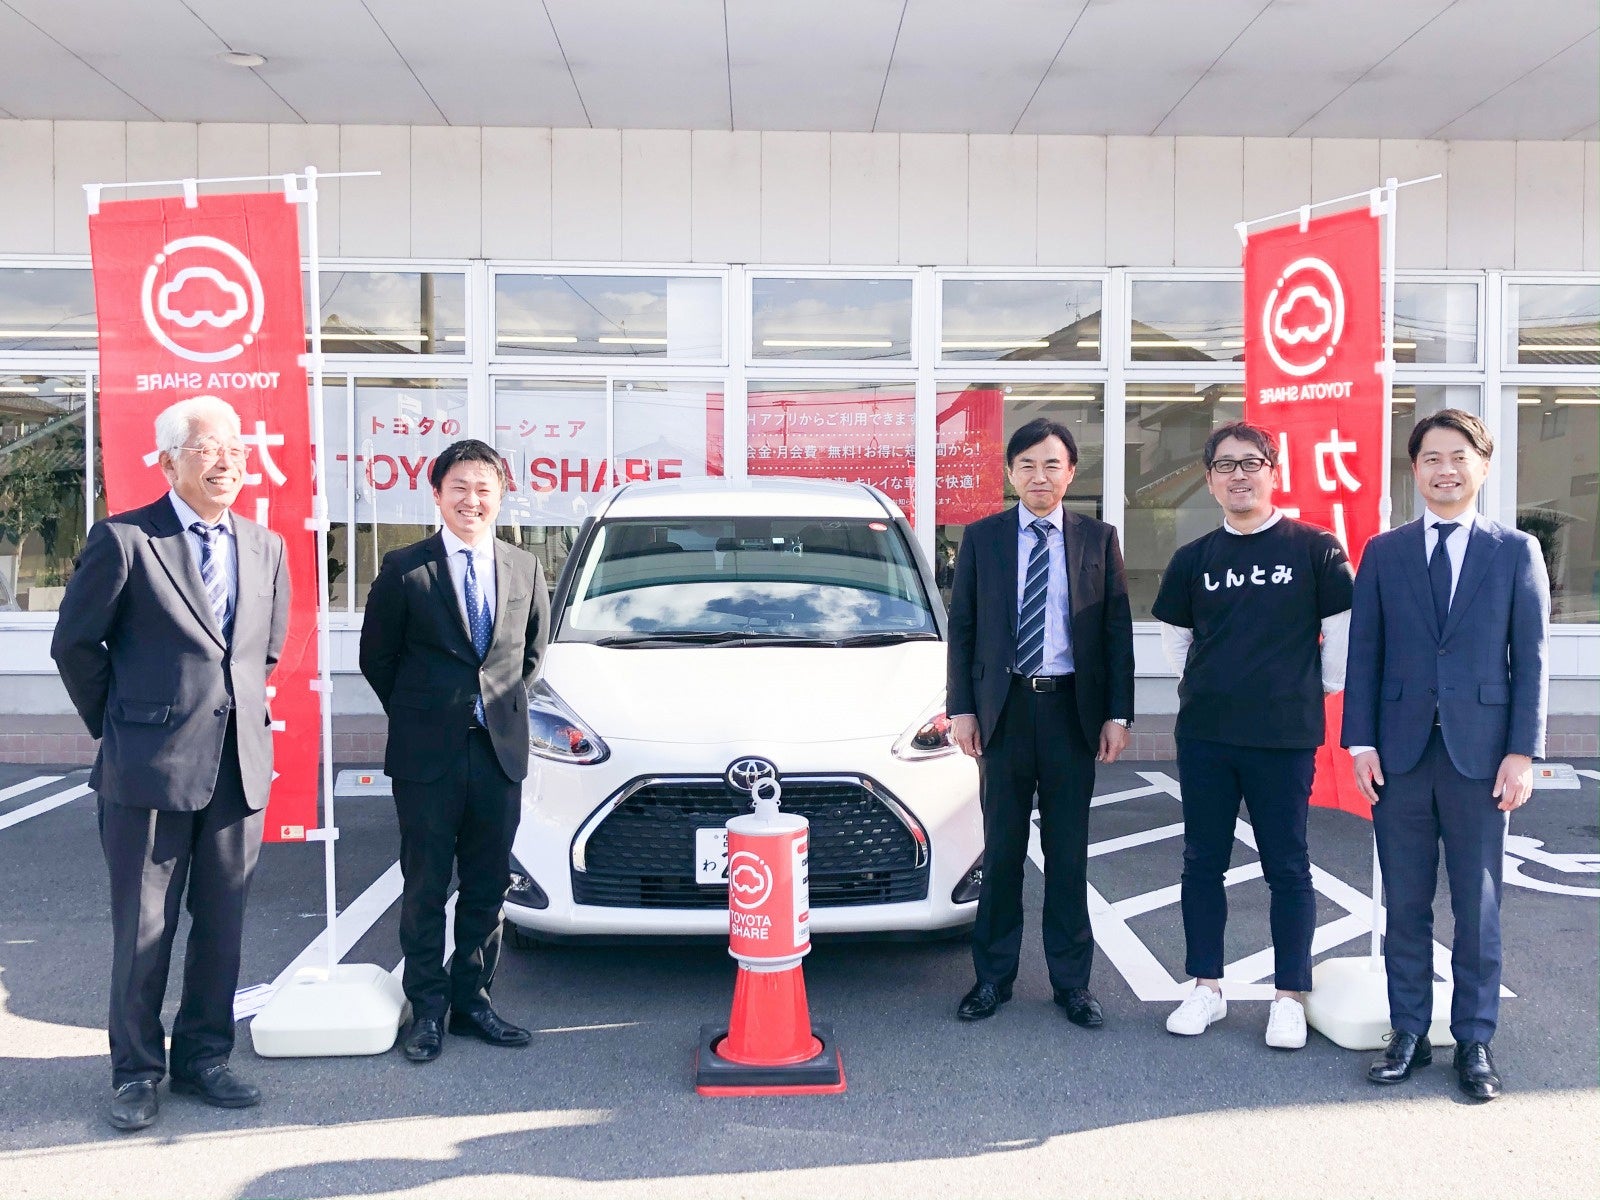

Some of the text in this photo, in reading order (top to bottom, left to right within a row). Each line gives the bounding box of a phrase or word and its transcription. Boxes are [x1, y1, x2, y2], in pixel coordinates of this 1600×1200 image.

[372, 415, 586, 438] トヨタのーシェア
[1203, 564, 1293, 591] しんとみ
[730, 909, 772, 927] TOYOTA
[731, 923, 769, 940] SHARE
